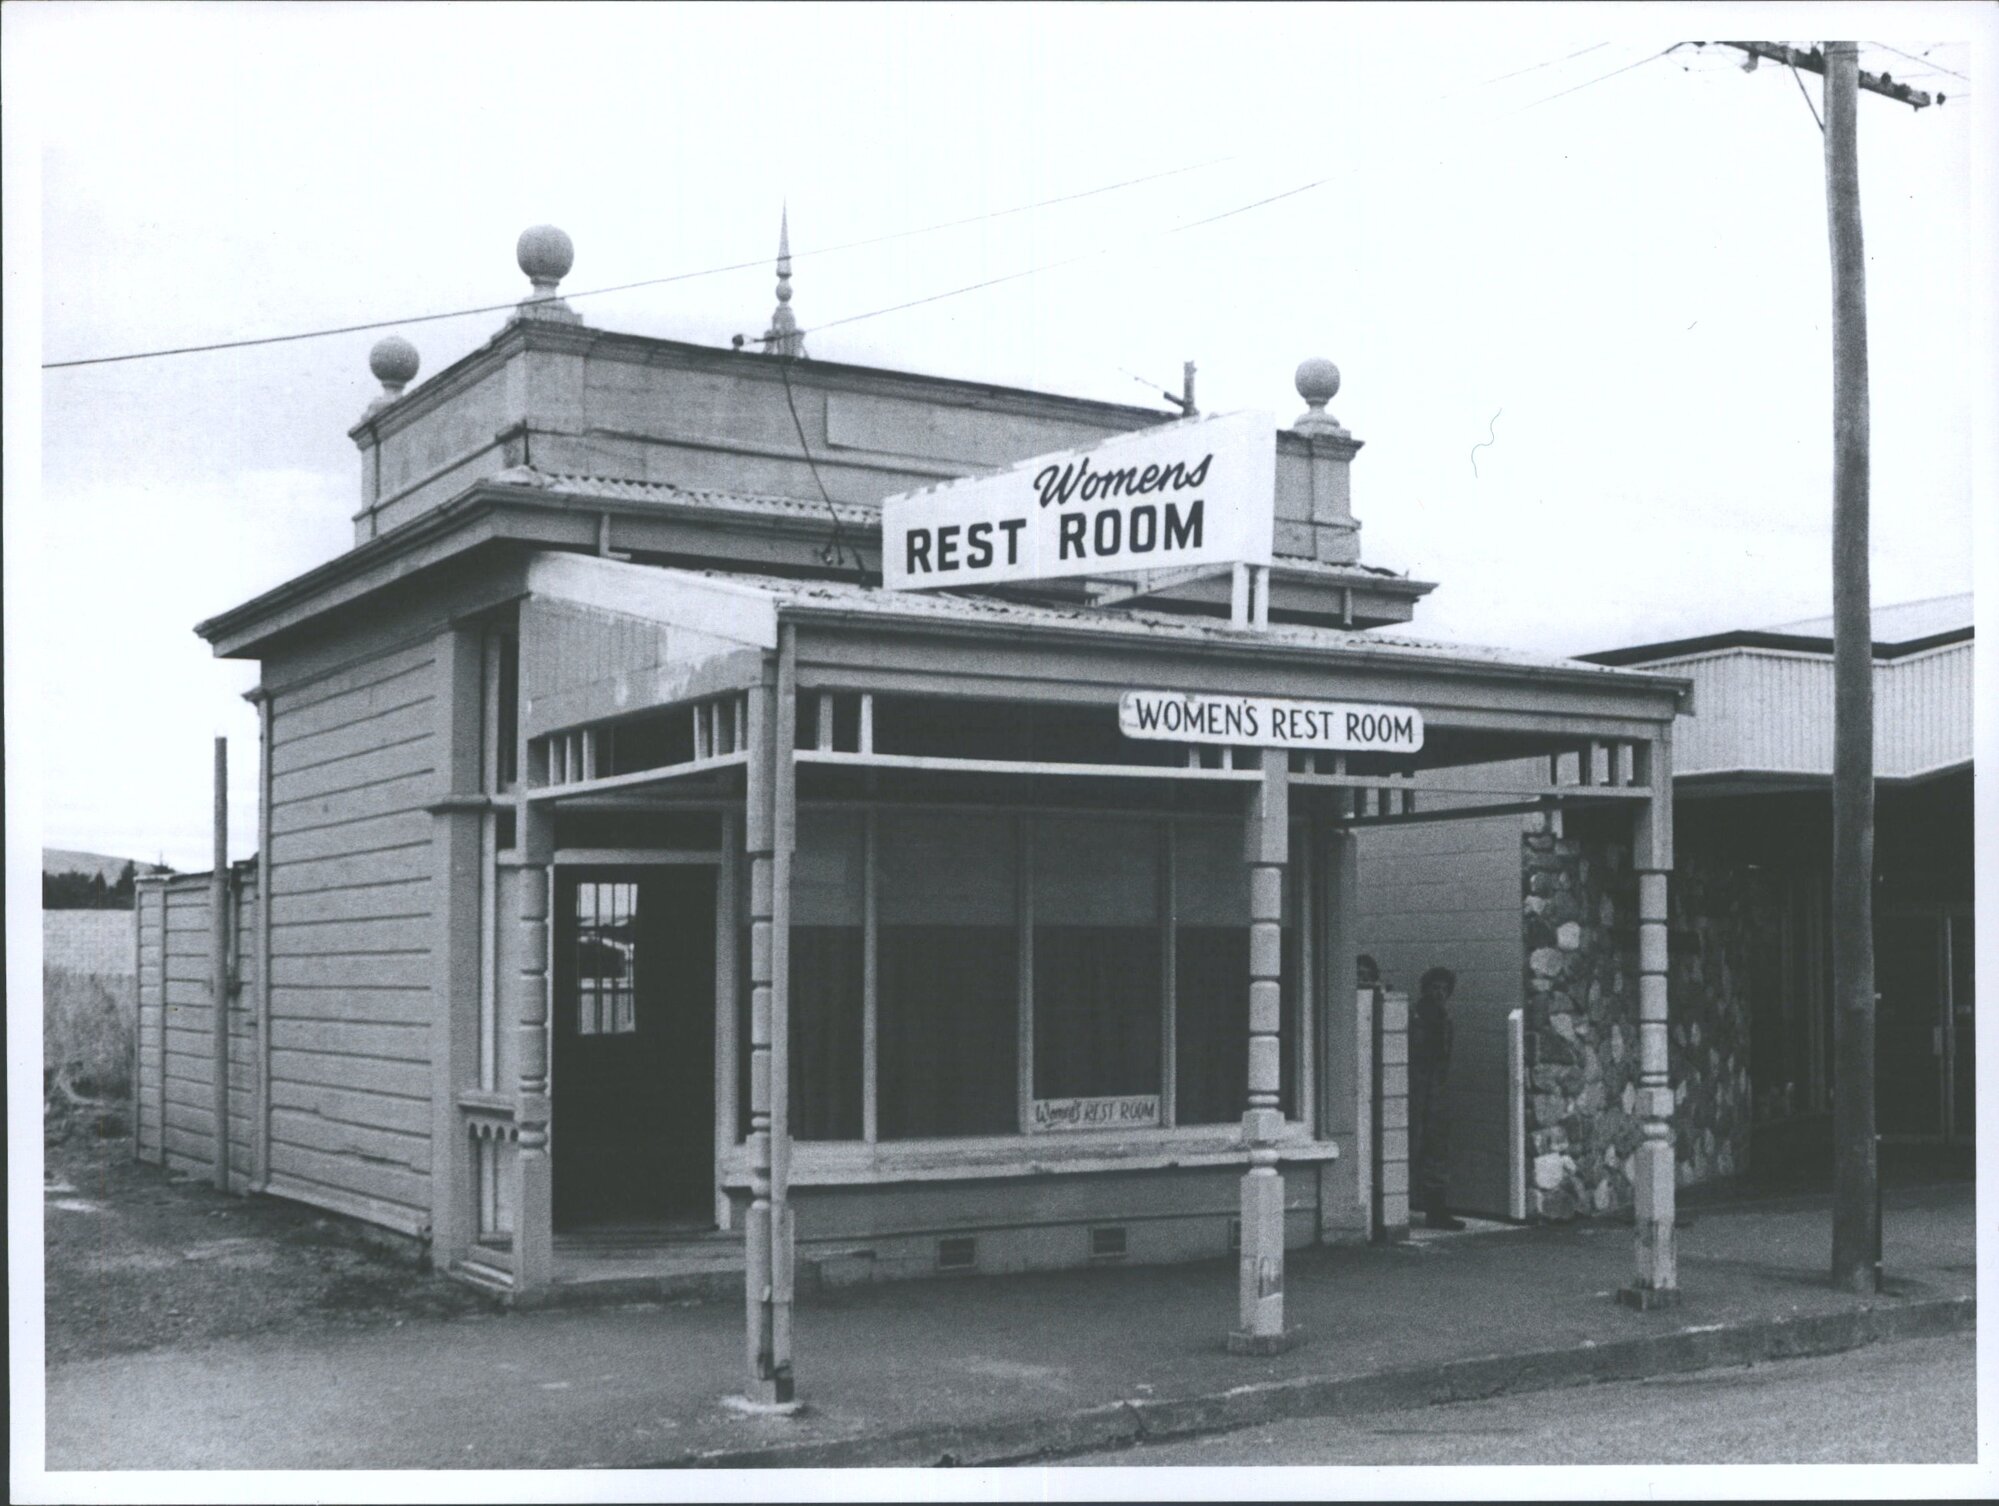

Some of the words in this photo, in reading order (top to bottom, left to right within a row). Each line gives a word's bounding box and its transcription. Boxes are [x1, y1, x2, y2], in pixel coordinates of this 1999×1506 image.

[1033, 453, 1214, 508] Womens
[906, 518, 1027, 575] REST
[1059, 499, 1205, 561] ROOM
[1135, 698, 1259, 737] WOMEN'S
[1272, 708, 1333, 741] REST
[1346, 711, 1413, 744] ROOM
[1120, 1101, 1155, 1120] ROOM
